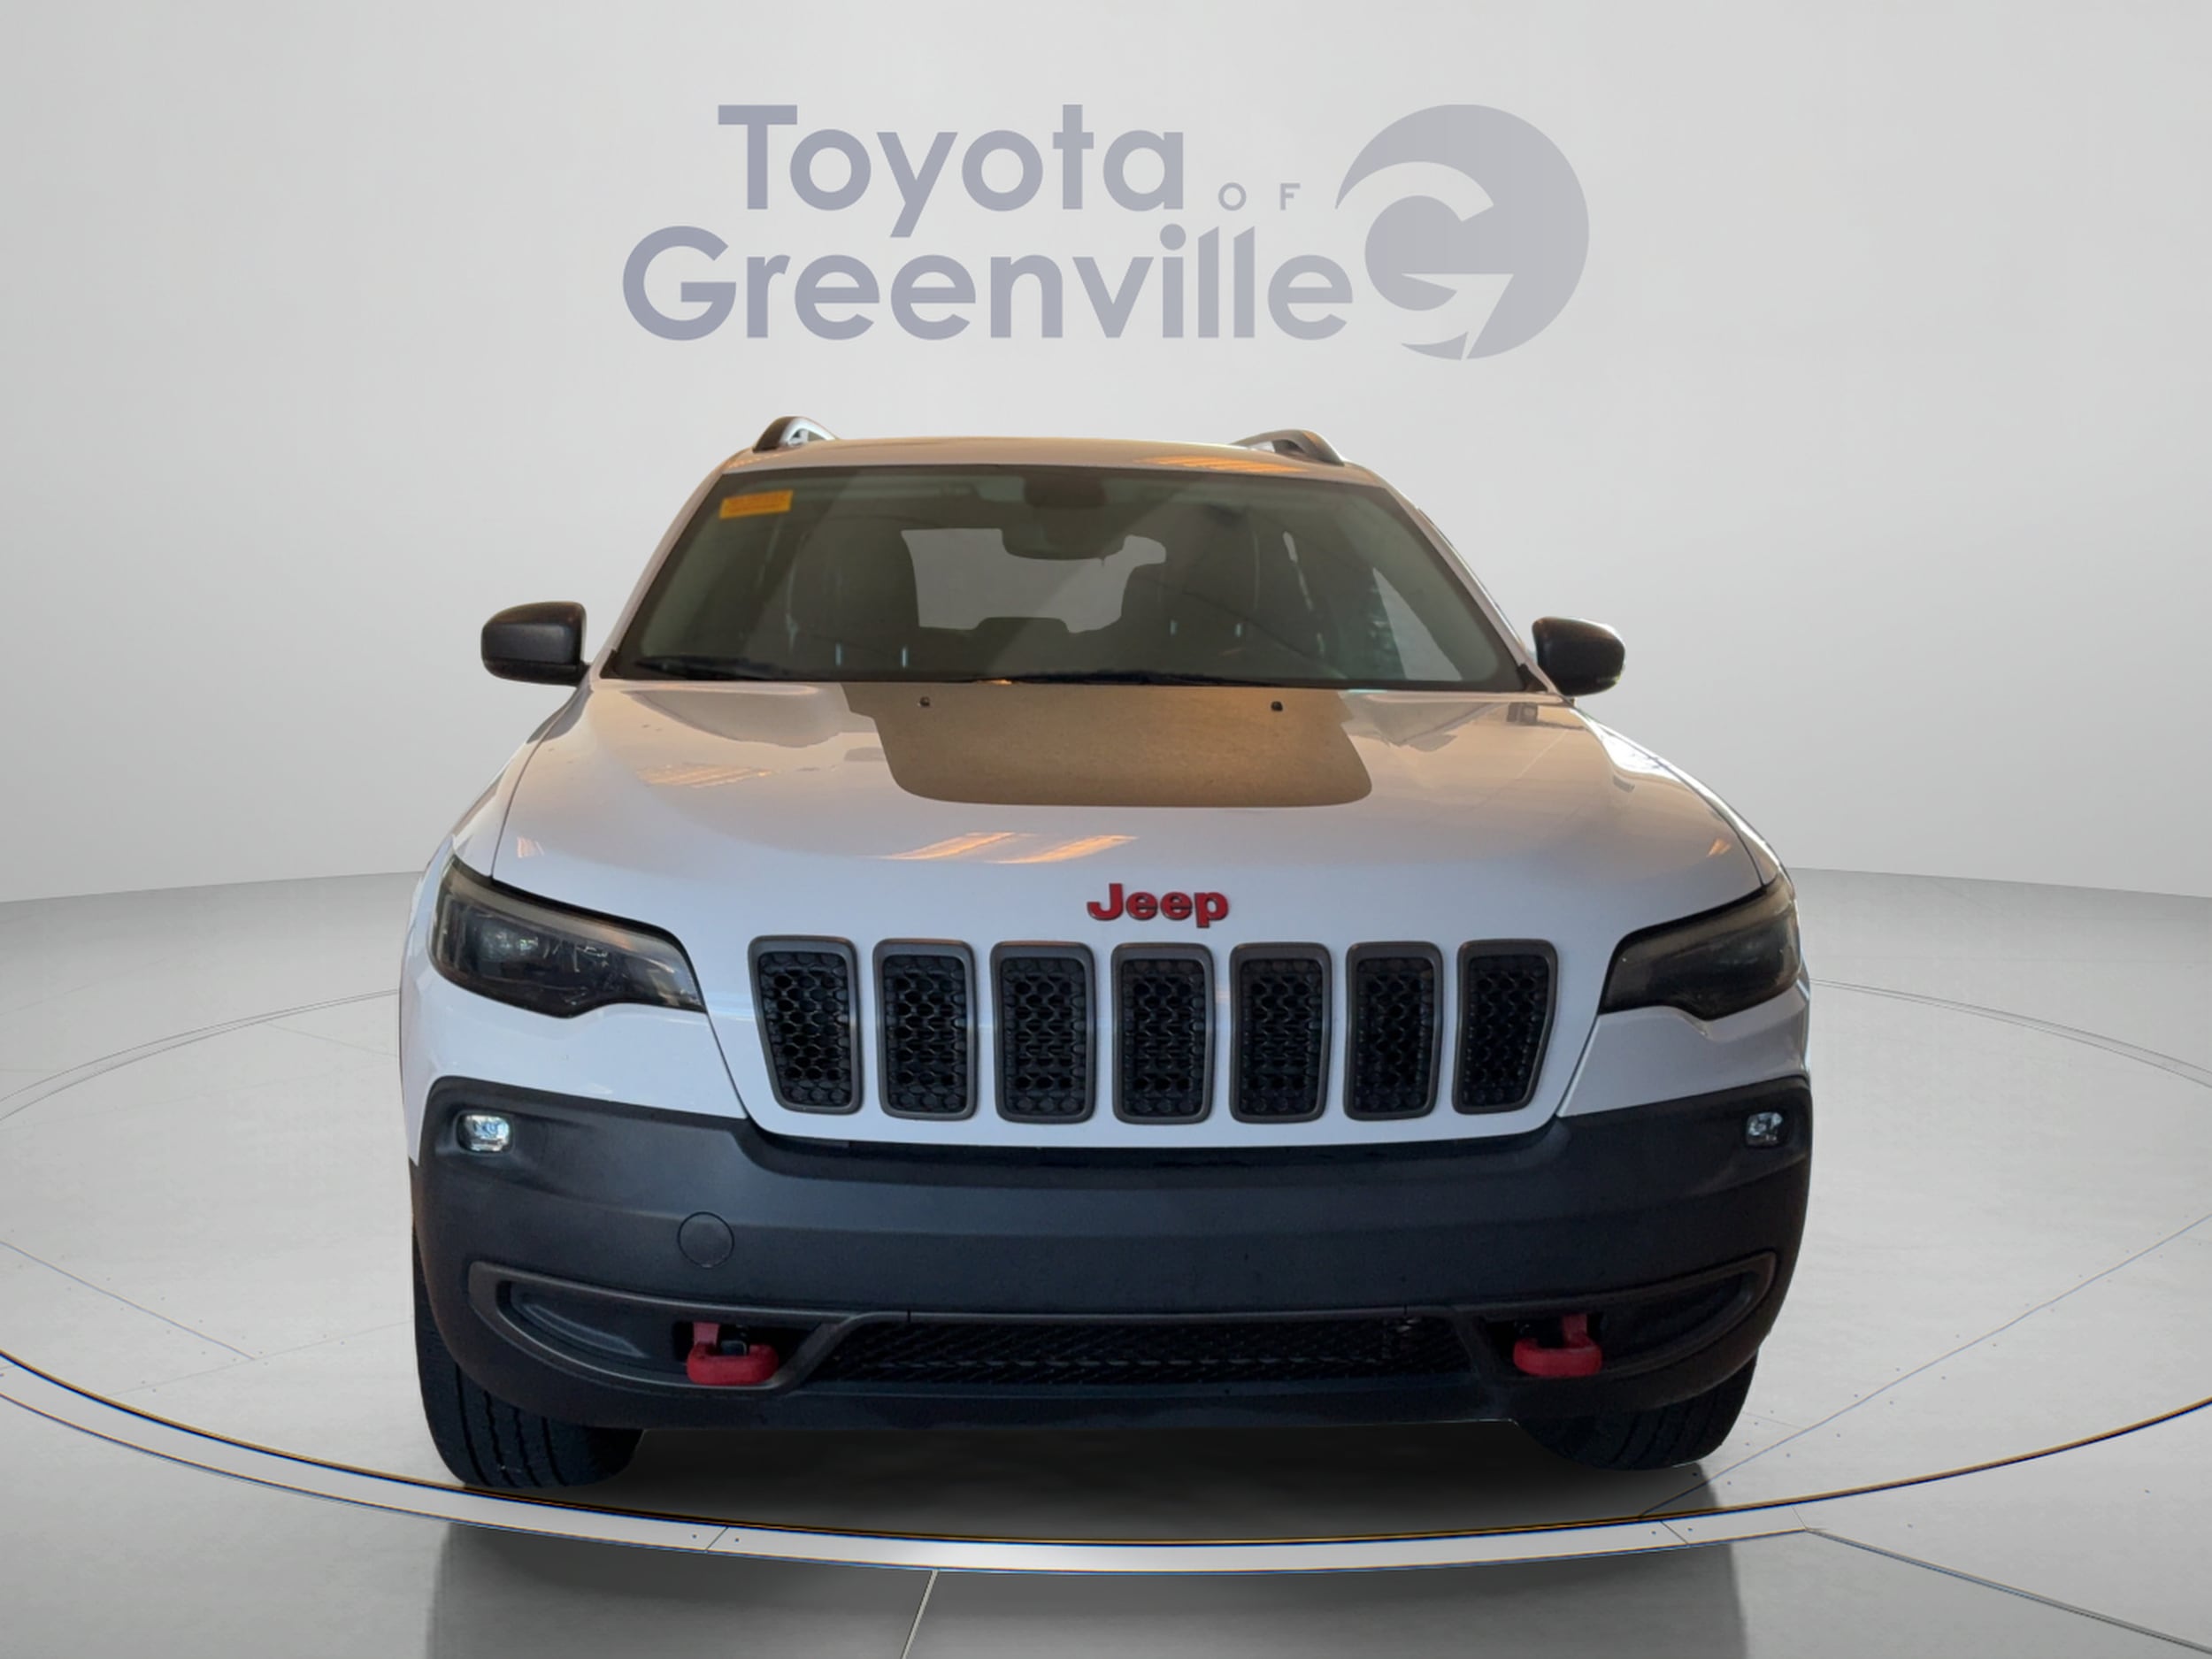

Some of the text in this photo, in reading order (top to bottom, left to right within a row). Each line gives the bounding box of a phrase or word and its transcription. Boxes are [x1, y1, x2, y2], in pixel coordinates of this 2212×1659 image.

[718, 104, 1302, 238] Toyota OF
[622, 223, 1354, 342] Greenville
[1087, 882, 1229, 929] Jeep
